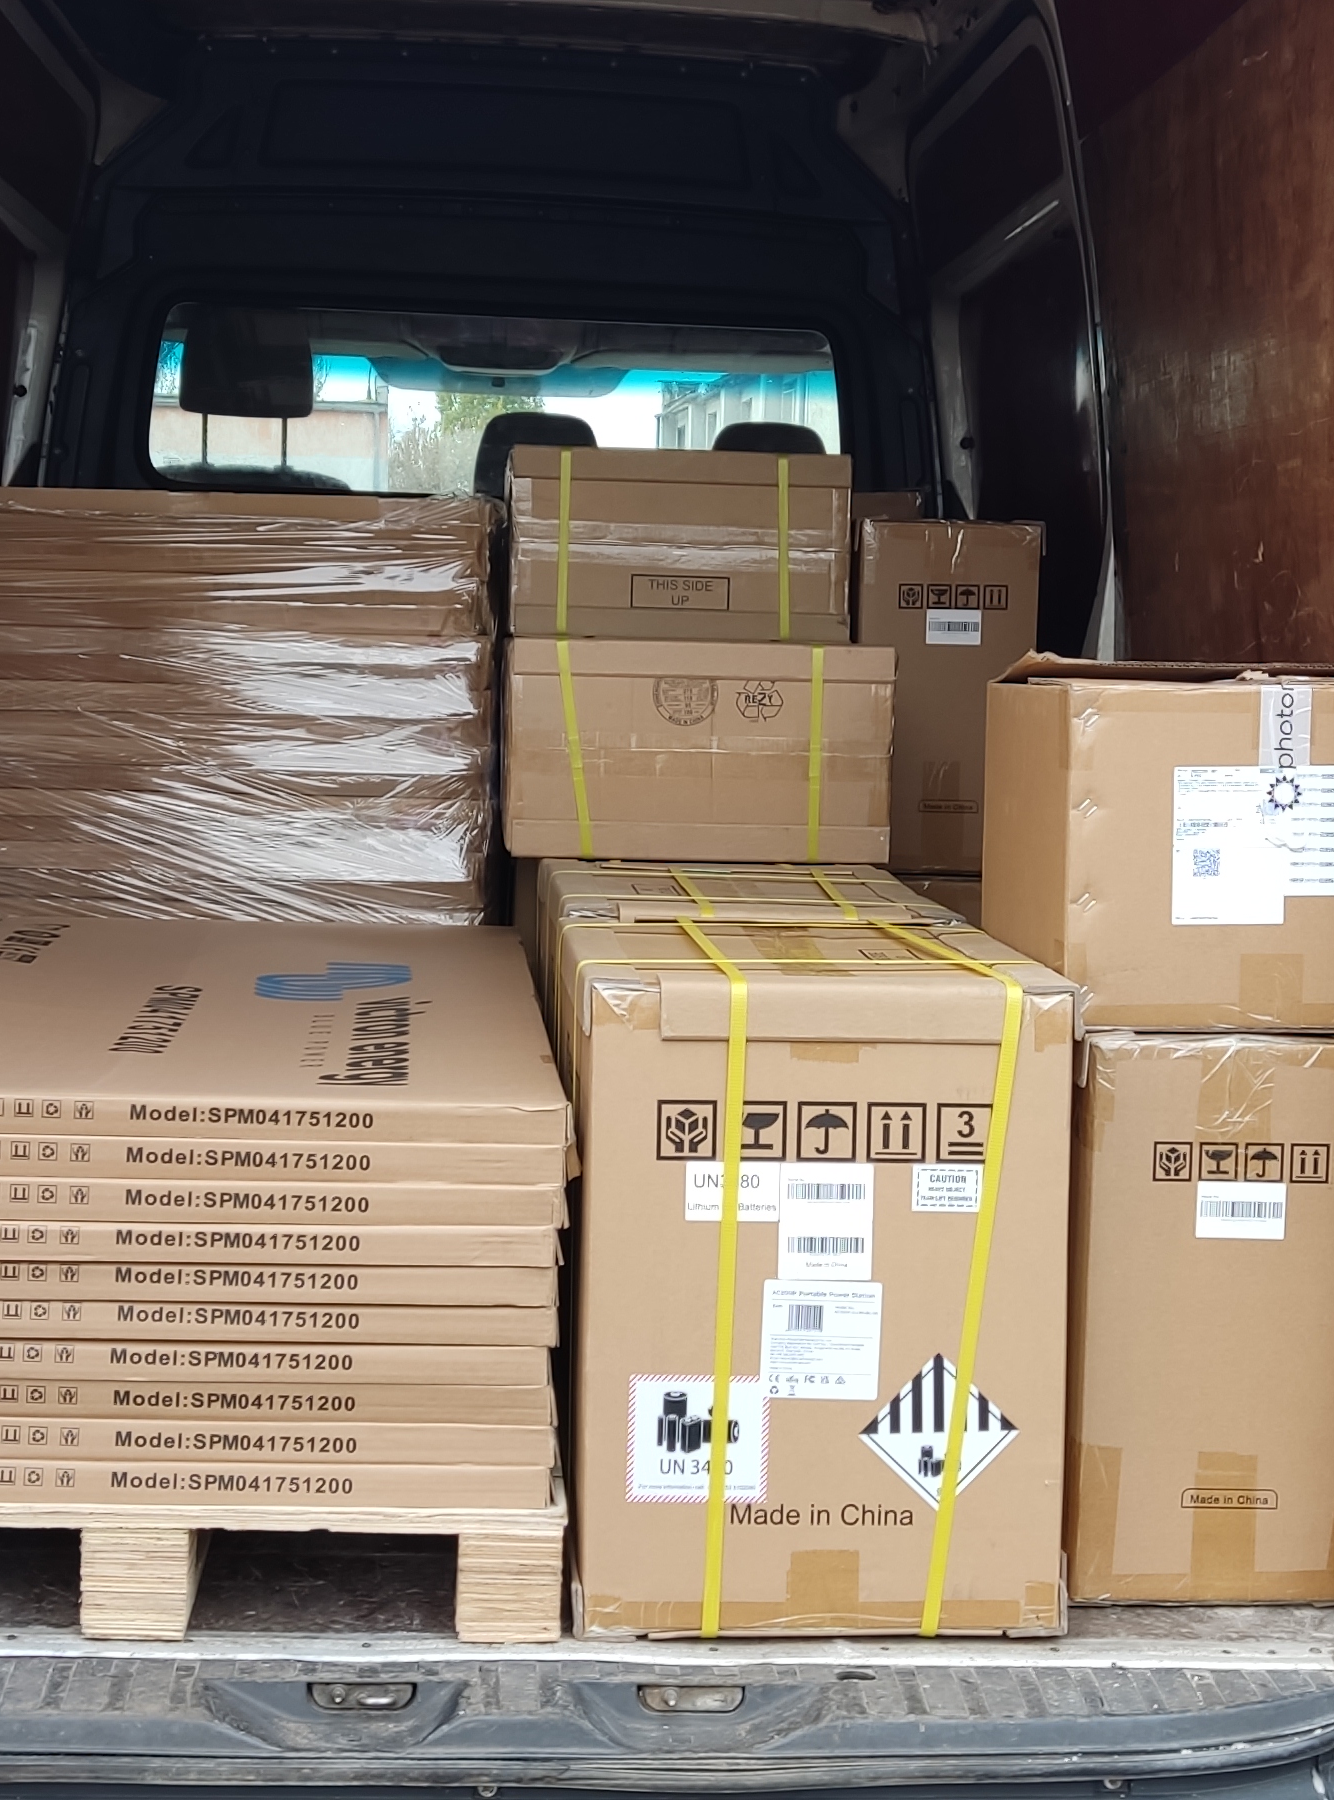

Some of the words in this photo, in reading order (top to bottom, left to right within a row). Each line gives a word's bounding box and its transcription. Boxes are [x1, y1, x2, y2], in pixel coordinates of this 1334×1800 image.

[648, 578, 678, 591] THIS
[682, 579, 714, 592] SIDE
[671, 595, 689, 606] UP
[107, 984, 204, 1053] SPM041751200
[351, 995, 433, 1041] victron
[315, 1041, 410, 1086] energy
[130, 1104, 373, 1129] Model:SPM041751200
[957, 1110, 975, 1138] 3
[126, 1147, 370, 1171] Model:SPM041751200
[693, 1174, 760, 1189] UN80
[126, 1189, 369, 1214] Model:SPM041751200
[116, 1230, 361, 1252] Model:SPM041751200
[115, 1267, 359, 1291] Model:SPM041751200
[117, 1305, 360, 1330] Model:SPM041751200
[110, 1347, 353, 1371] Model:SPM041751200
[113, 1390, 356, 1412] Model:SPM041751200
[115, 1431, 357, 1454] Model:SPM041751200
[660, 1458, 685, 1475] UN
[690, 1459, 734, 1475] 340
[111, 1471, 353, 1495] Model:SPM041751200
[1190, 1494, 1221, 1505] Made
[1223, 1494, 1234, 1505] in
[1236, 1495, 1269, 1505] China
[730, 1503, 800, 1527] Made
[810, 1503, 830, 1526] in
[841, 1503, 914, 1527] China
